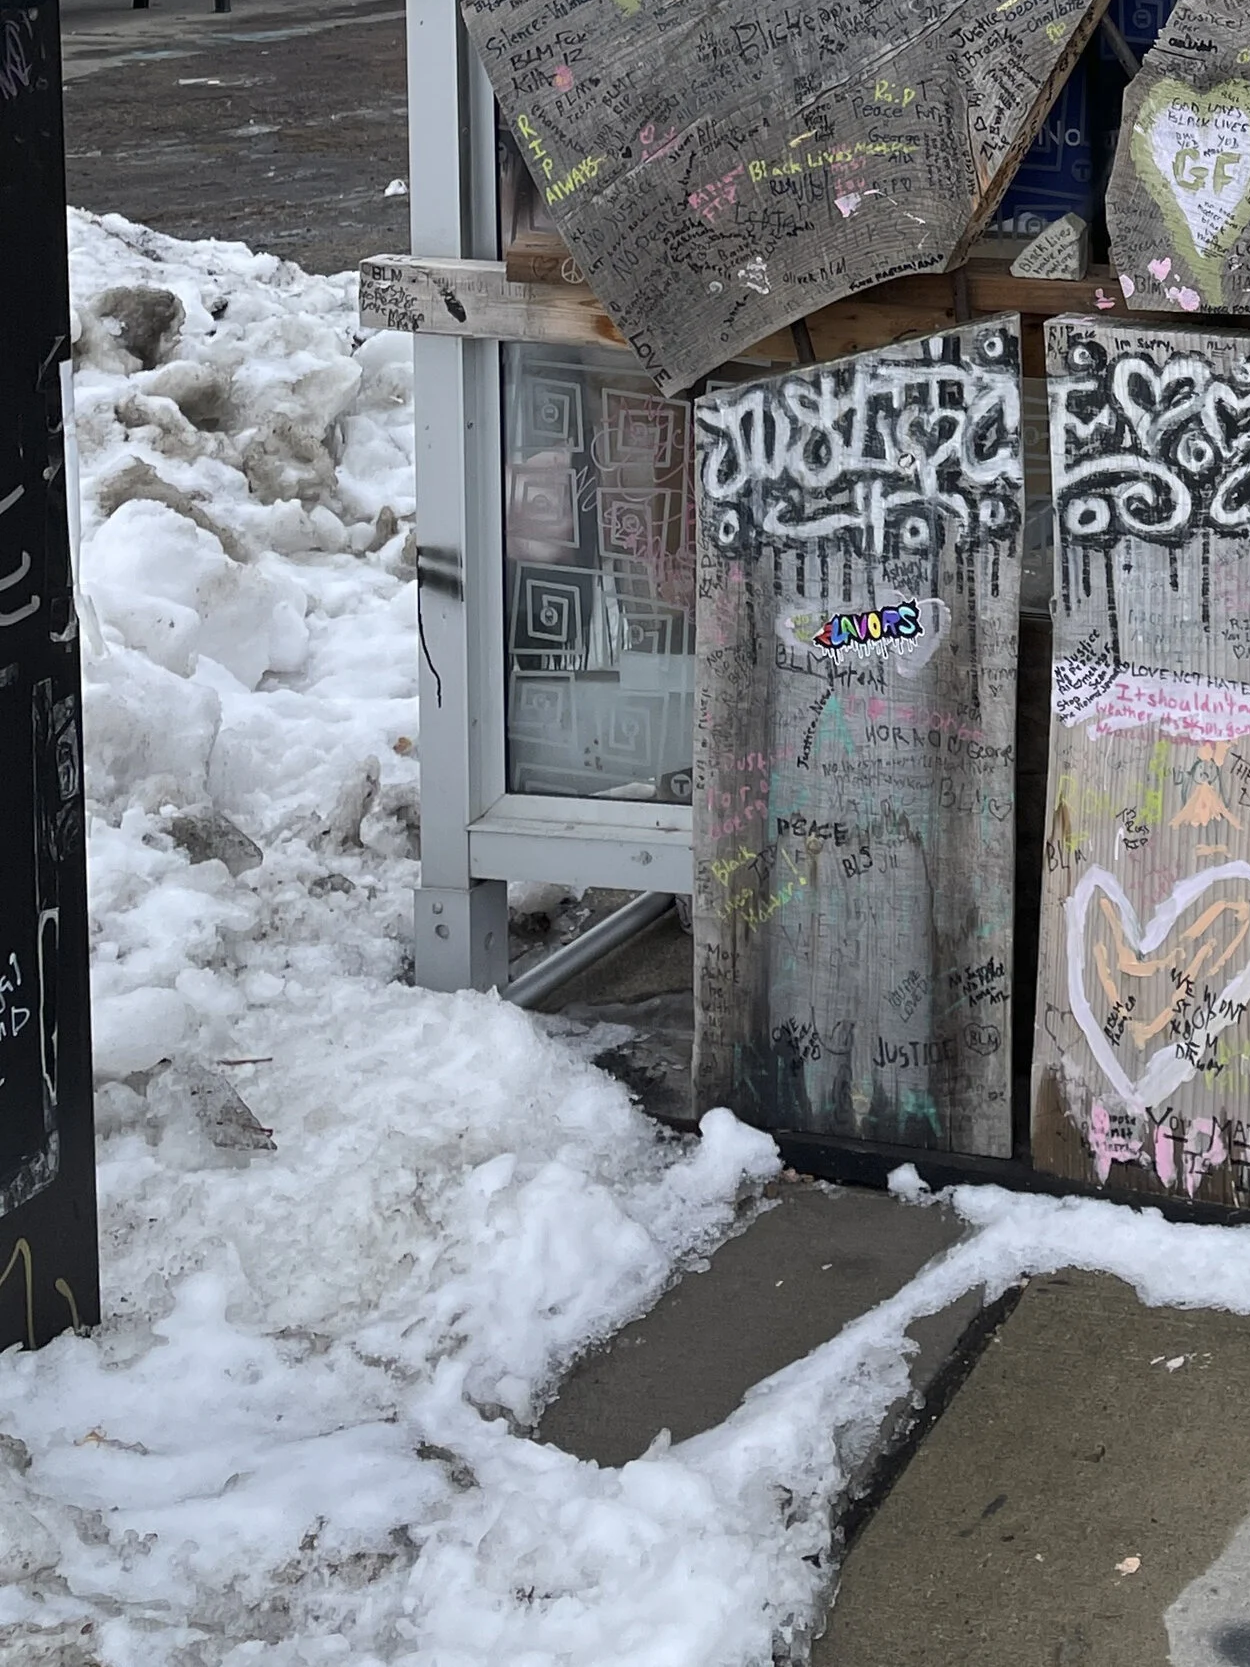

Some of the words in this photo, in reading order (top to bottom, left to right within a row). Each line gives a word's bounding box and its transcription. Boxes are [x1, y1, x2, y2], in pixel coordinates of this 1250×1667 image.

[510, 44, 554, 72] BLM
[1172, 149, 1241, 193] GF
[630, 333, 671, 388] LOVE
[1131, 663, 1168, 680] LOVE
